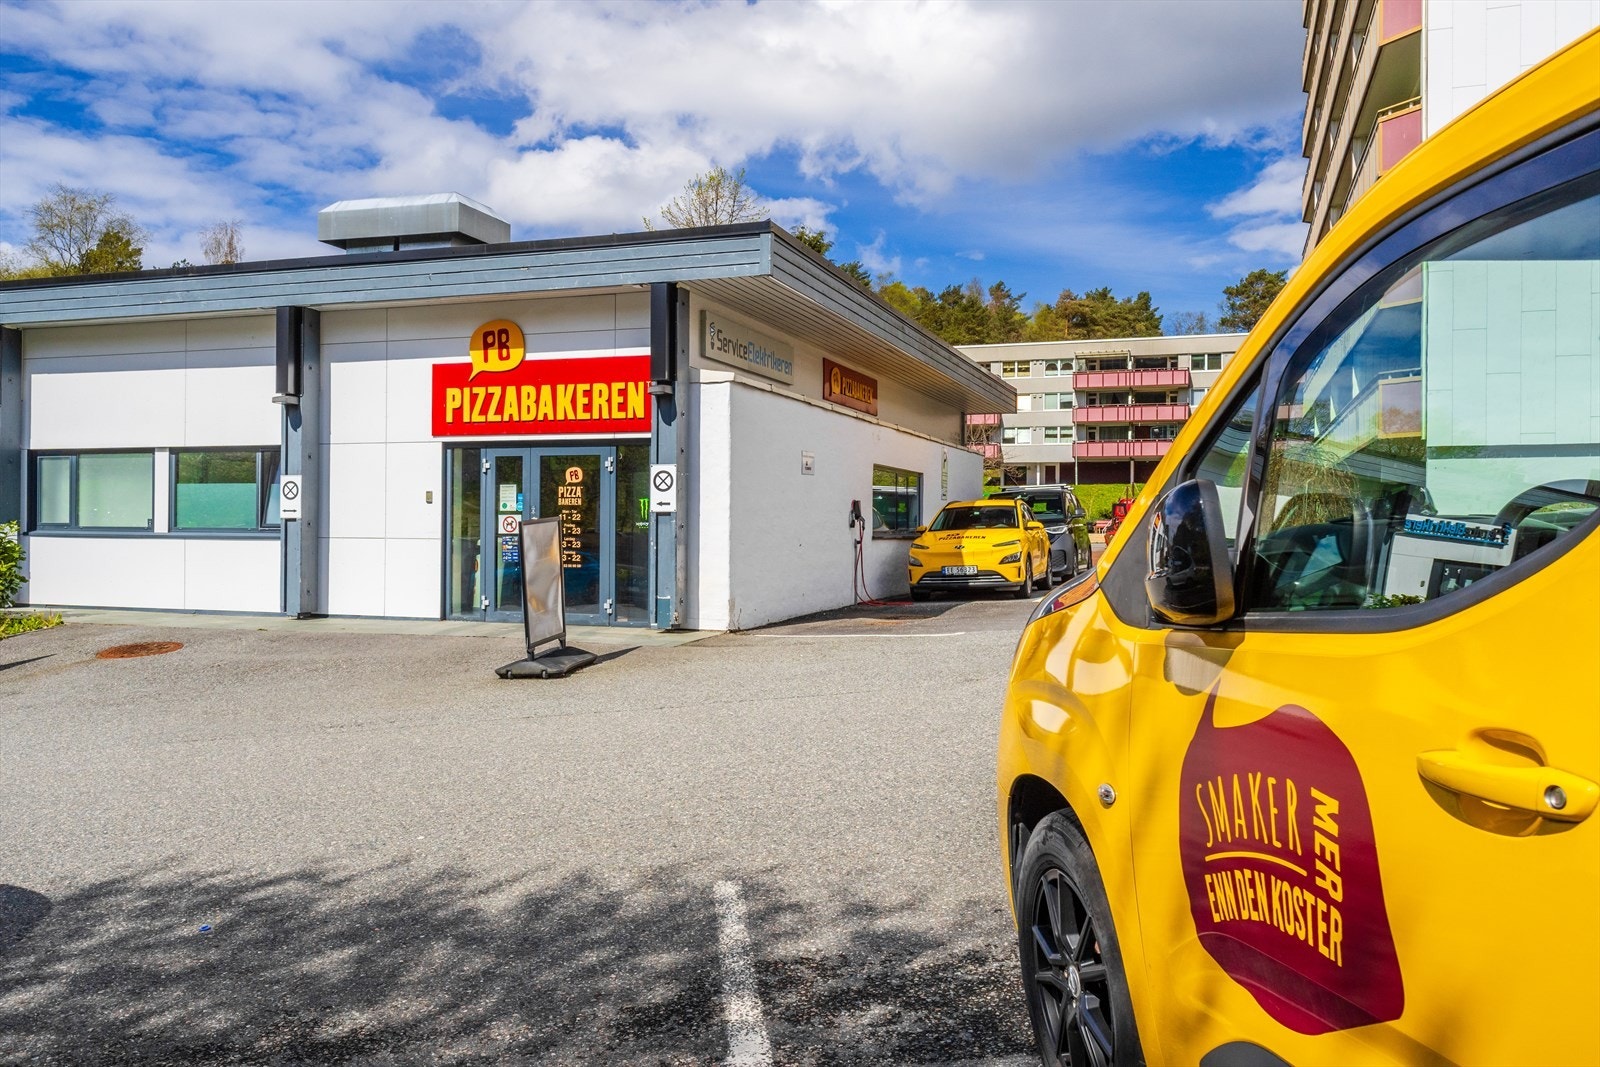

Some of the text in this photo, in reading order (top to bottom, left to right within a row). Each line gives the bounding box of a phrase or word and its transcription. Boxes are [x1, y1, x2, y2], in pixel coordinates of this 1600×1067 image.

[482, 328, 511, 363] PB
[716, 328, 793, 376] ServiceElektrikeren
[445, 381, 645, 423] PIZZABAKEREN
[558, 486, 582, 498] PIZZA
[558, 498, 582, 506] BAKEREN
[1196, 771, 1302, 856] SMAKER
[1310, 786, 1344, 903] MER
[1204, 868, 1343, 967] ENN DEN KOSTER
